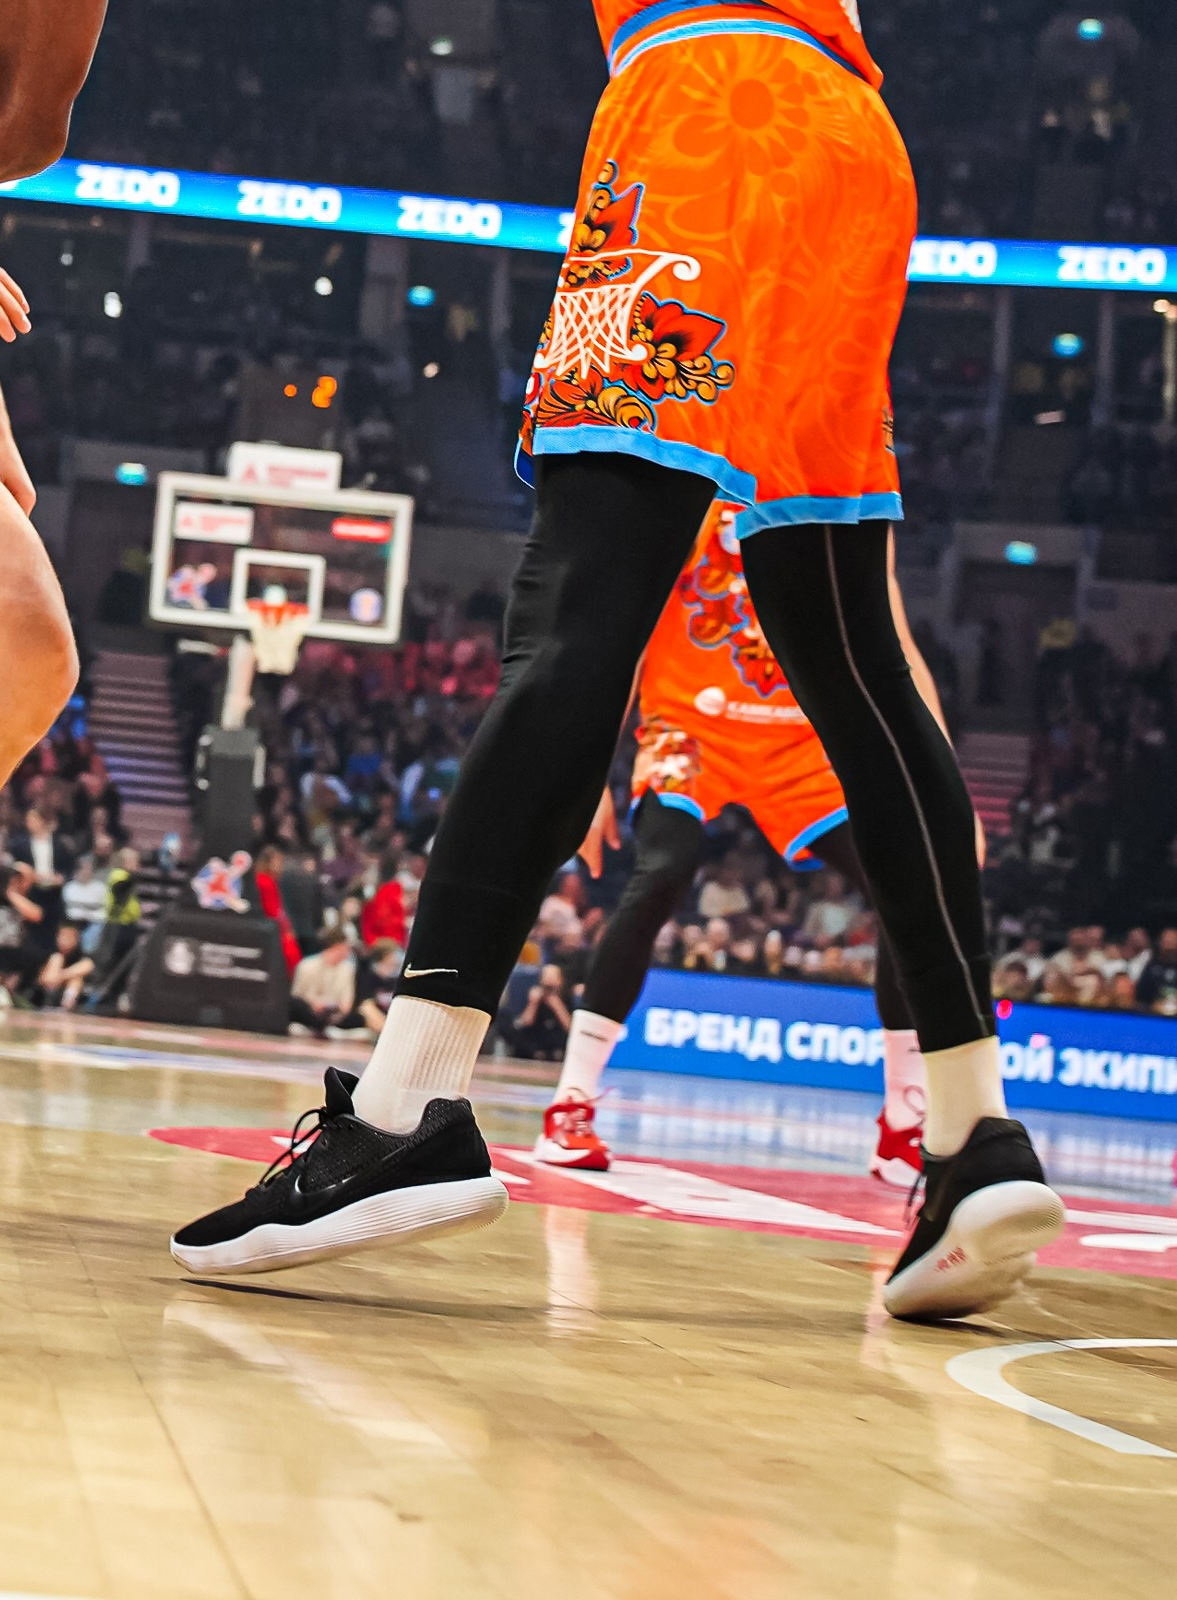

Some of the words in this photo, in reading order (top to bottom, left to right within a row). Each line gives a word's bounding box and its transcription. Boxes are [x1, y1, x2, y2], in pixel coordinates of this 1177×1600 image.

[75, 164, 180, 207] ZEDO
[237, 180, 342, 223] ZEDO
[398, 196, 502, 239] ZEDO
[910, 240, 997, 277] EDO
[1057, 246, 1167, 285] ZEDO
[645, 1007, 783, 1064] БРЕНД
